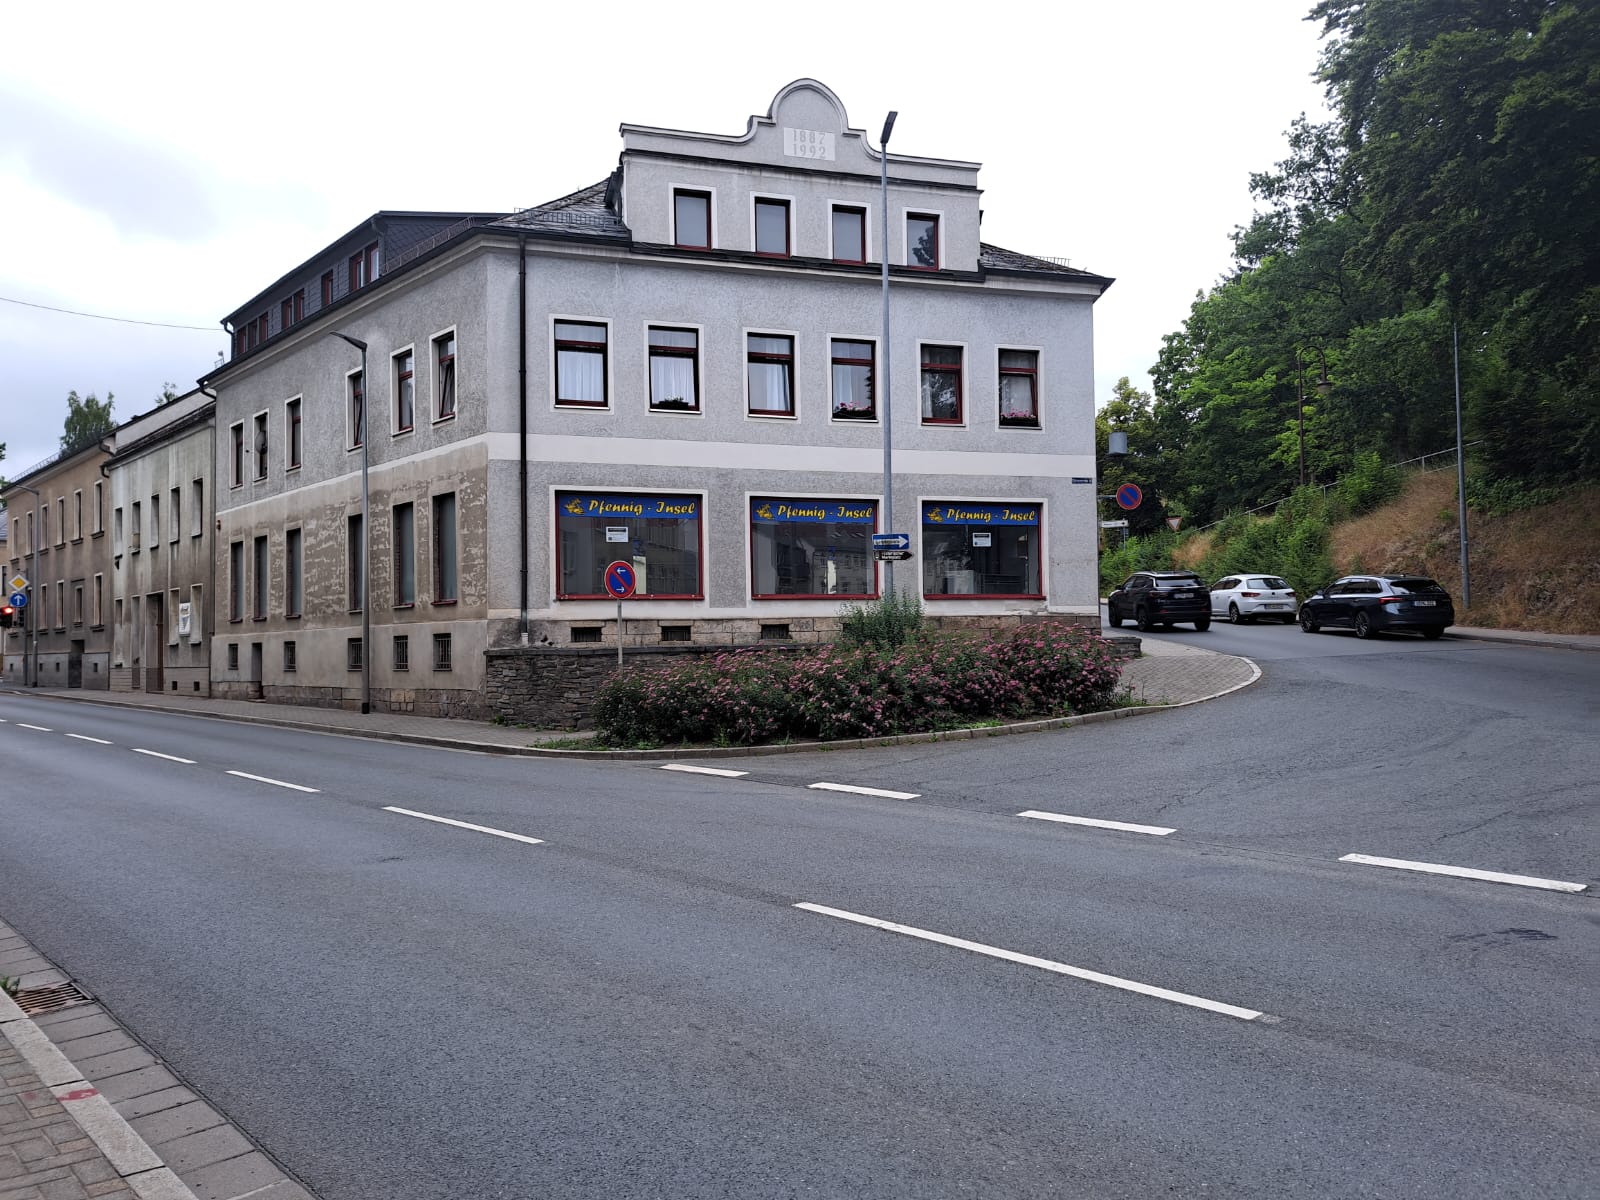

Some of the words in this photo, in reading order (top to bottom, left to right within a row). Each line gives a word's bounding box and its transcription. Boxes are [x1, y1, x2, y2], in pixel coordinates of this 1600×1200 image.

[793, 130, 826, 144] 1887
[793, 144, 826, 159] 1992
[589, 499, 643, 516] Pfennig
[656, 501, 695, 514] Insel
[777, 505, 825, 520] Pfennig
[837, 506, 873, 518] Insel
[946, 508, 991, 523] Pfennig
[1002, 509, 1035, 521] Insel
